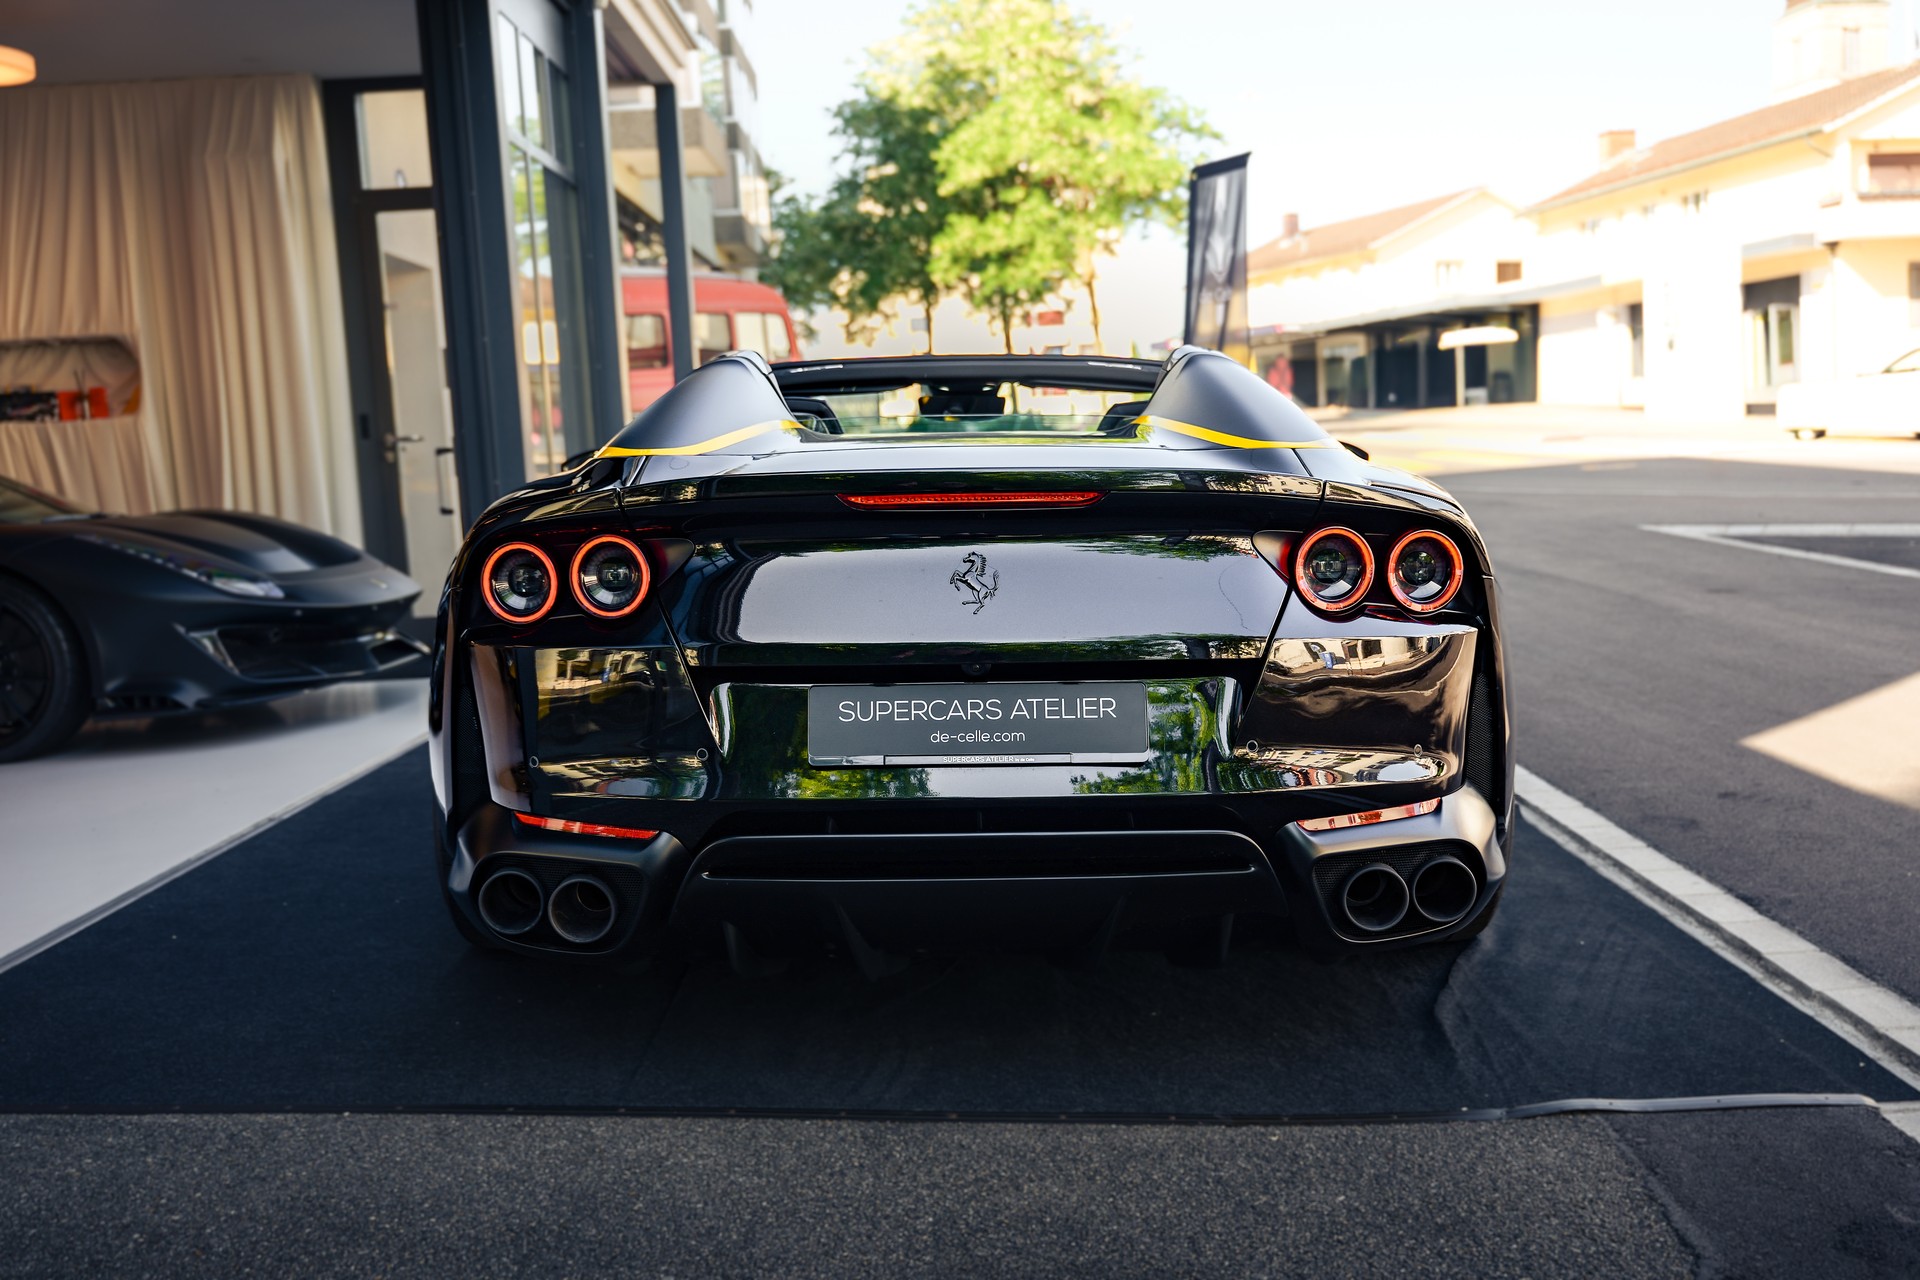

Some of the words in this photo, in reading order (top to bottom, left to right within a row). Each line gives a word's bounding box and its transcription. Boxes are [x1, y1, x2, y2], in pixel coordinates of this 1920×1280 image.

[838, 699, 1003, 722] SUPERCARS
[1010, 698, 1117, 720] ATELIER
[930, 730, 1026, 743] de-celle.com
